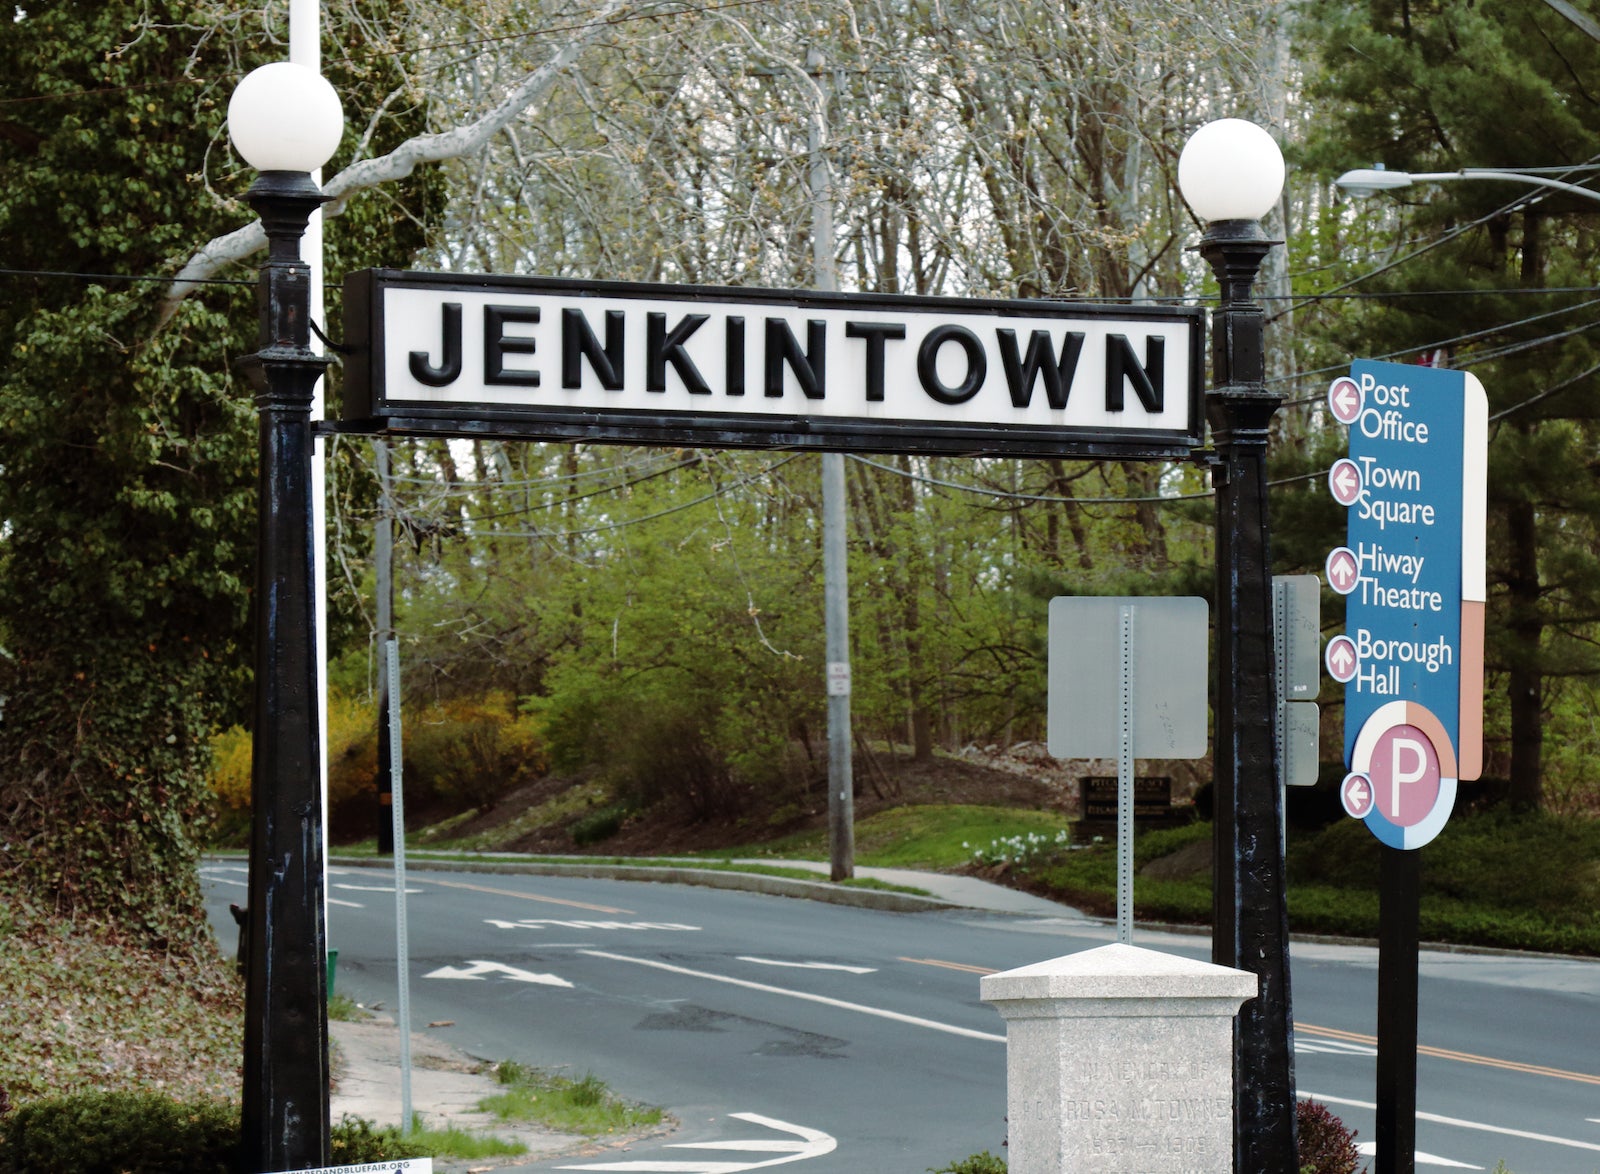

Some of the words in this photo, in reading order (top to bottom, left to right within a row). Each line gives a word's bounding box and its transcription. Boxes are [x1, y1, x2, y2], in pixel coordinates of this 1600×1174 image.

[408, 302, 1164, 414] JENKINTOWN
[1361, 373, 1410, 408] Post
[1360, 407, 1429, 443] Office
[1358, 455, 1421, 491] Town
[1358, 489, 1435, 530] Square
[1358, 541, 1425, 584] Hiway
[1358, 576, 1442, 611] Theatre
[1357, 628, 1453, 673] Borough
[1356, 663, 1400, 695] Hall
[1391, 737, 1428, 817] P
[1190, 1061, 1210, 1080] OF
[1066, 1100, 1119, 1120] ROSA
